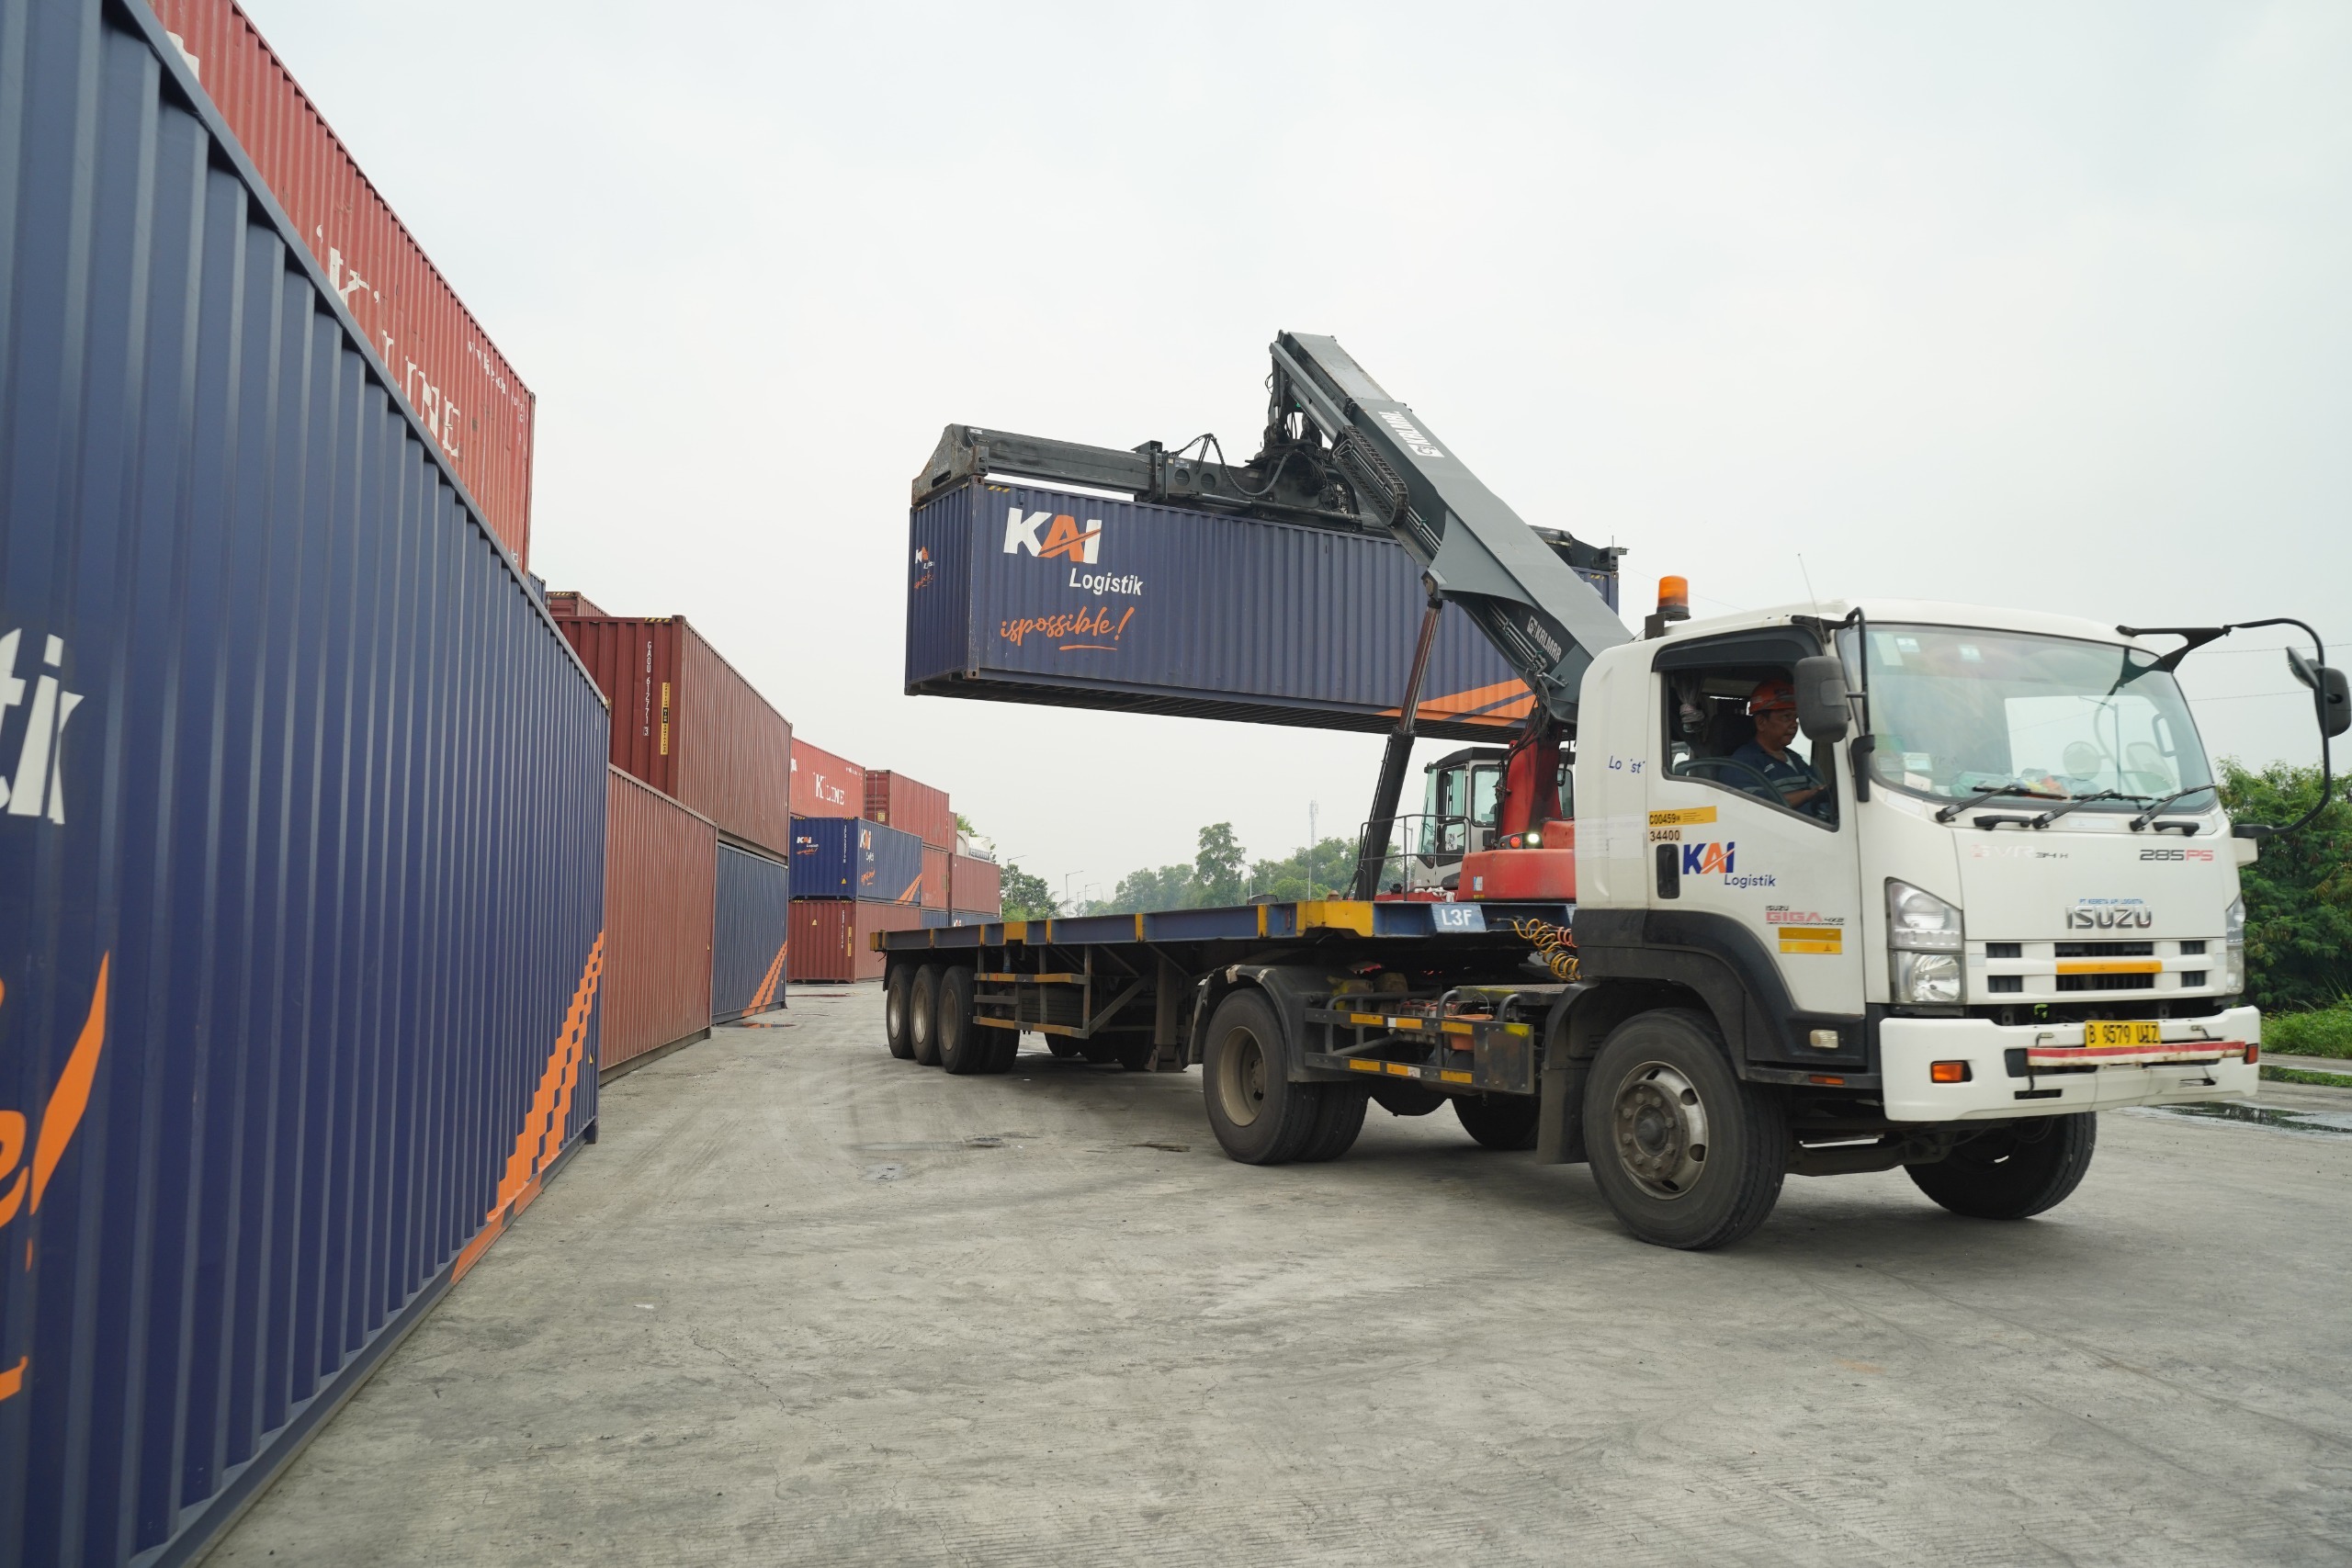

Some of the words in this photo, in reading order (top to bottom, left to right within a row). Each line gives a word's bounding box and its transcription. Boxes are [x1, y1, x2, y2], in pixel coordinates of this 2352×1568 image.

[1003, 507, 1102, 564] KAI
[1069, 568, 1144, 596] Logistik
[1535, 625, 1562, 663] KALMAR
[644, 727, 650, 736] 3
[1650, 829, 1680, 841] 34400
[1682, 841, 1736, 874] KAI
[2140, 849, 2214, 862] 285PS
[1724, 874, 1777, 889] Logistik
[1441, 908, 1472, 926] L3F
[1766, 911, 1823, 922] GIGA
[2065, 905, 2153, 930] ISUZU
[2088, 1024, 2096, 1043] B
[2102, 1024, 2132, 1043] 9579
